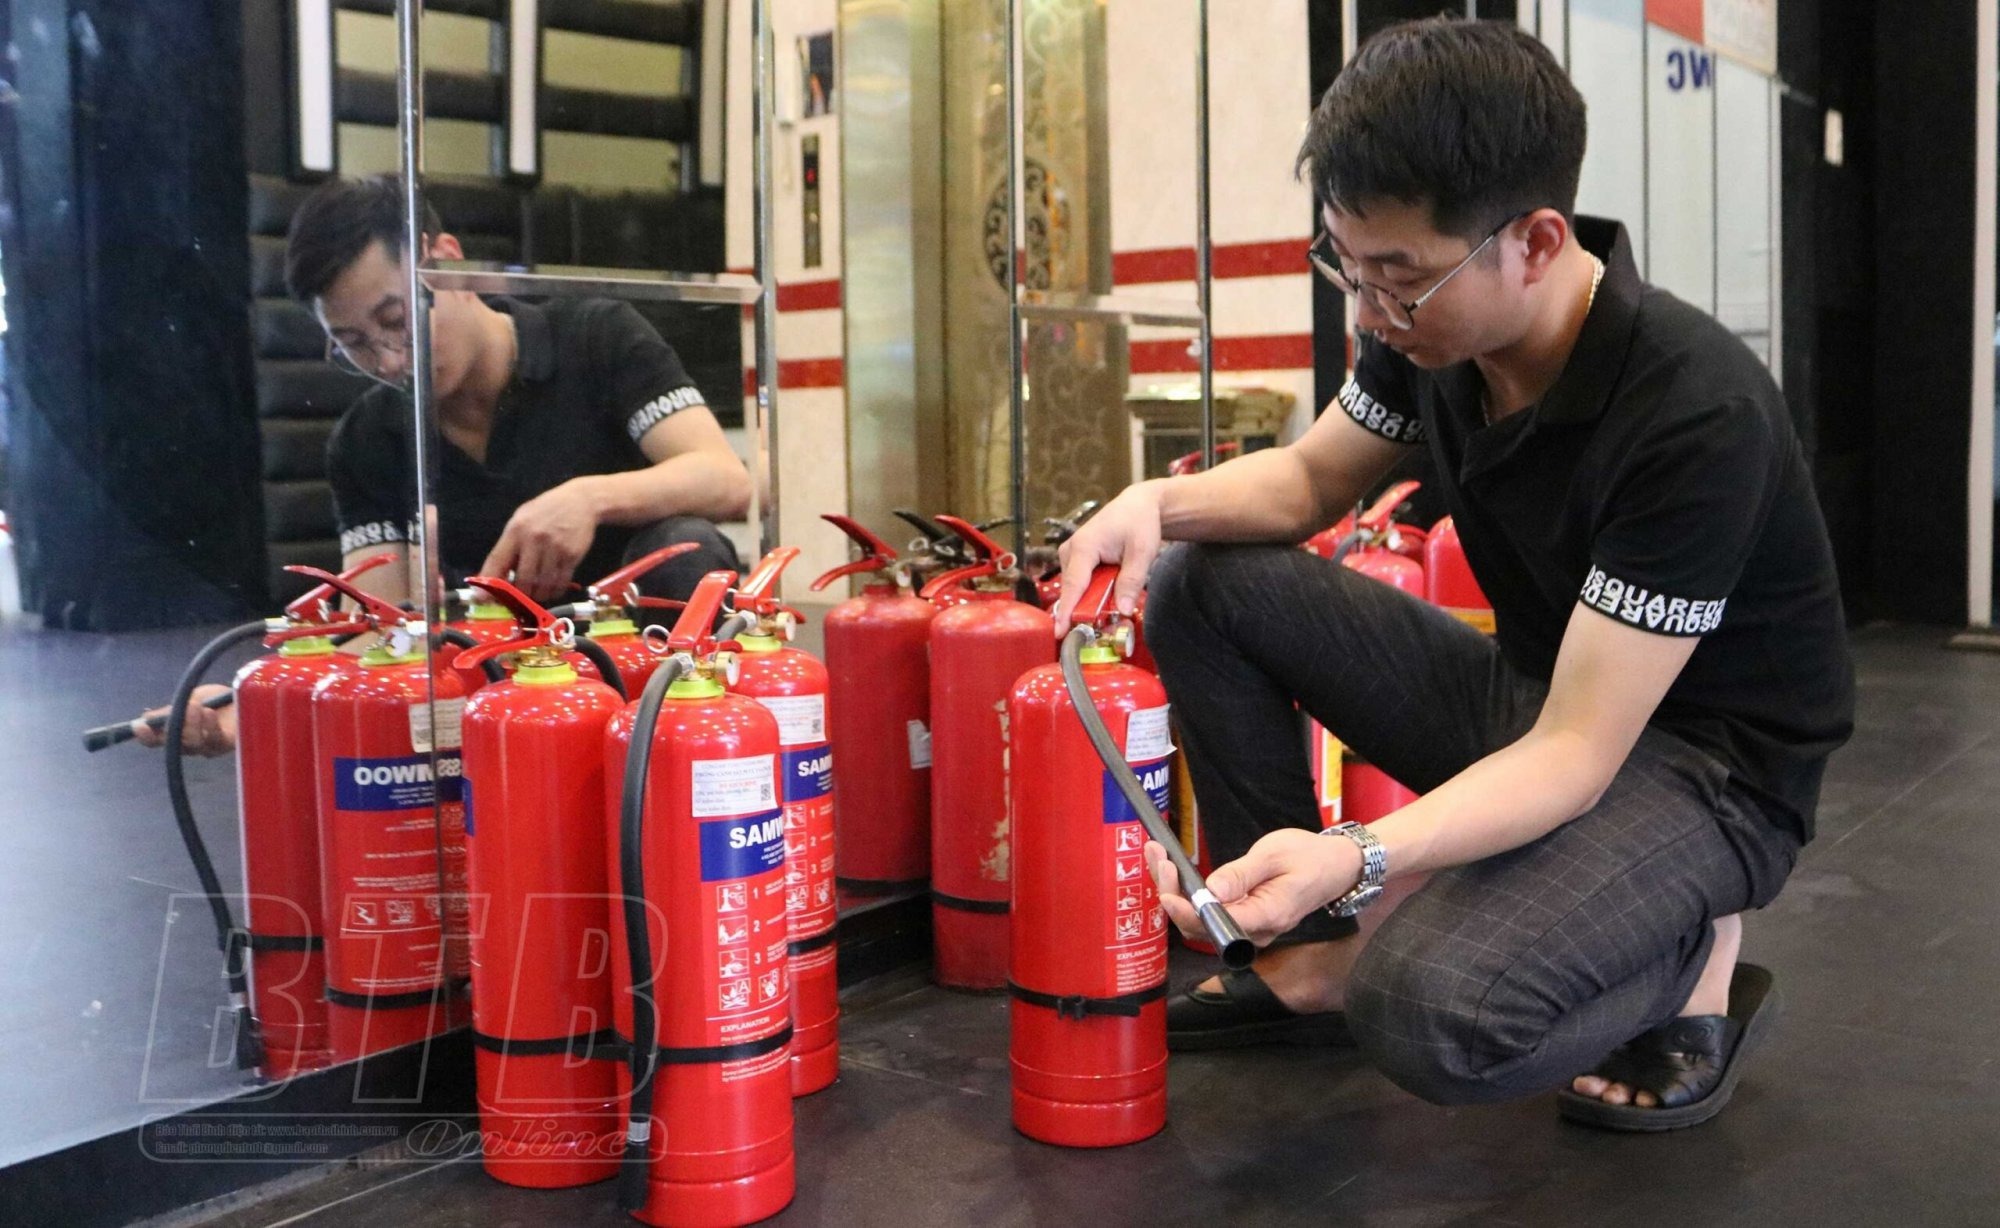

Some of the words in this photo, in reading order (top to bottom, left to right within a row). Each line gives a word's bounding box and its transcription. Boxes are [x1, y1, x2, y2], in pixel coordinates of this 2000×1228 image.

[810, 836, 817, 847] 2
[811, 864, 817, 874] 3
[753, 887, 759, 899] 1
[753, 920, 760, 932] 2
[754, 952, 761, 964] 3
[720, 1016, 770, 1033] EXPLANATION
